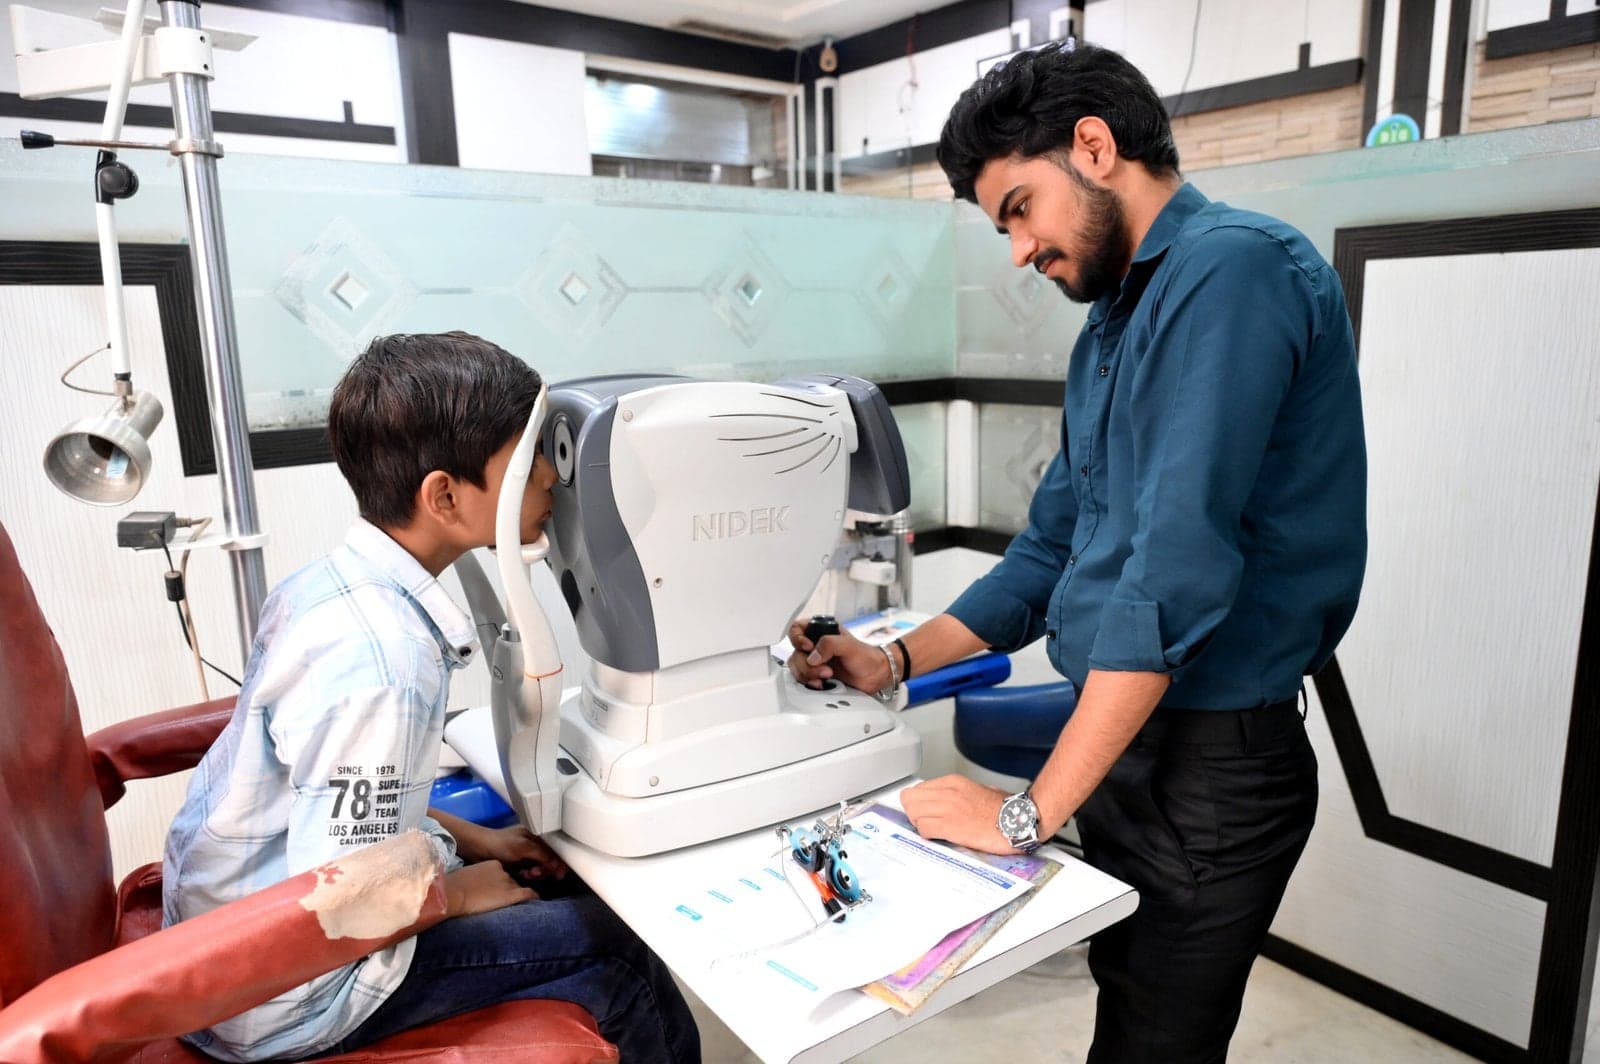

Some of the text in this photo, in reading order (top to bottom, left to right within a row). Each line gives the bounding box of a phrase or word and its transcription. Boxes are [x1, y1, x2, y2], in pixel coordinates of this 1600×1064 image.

[692, 505, 790, 541] NIDEK
[337, 765, 396, 775] SINCE 1978
[328, 779, 371, 820] 78
[376, 793, 398, 804] RIOR
[375, 807, 399, 818] TEAM
[328, 822, 399, 836] LOS ANGELES
